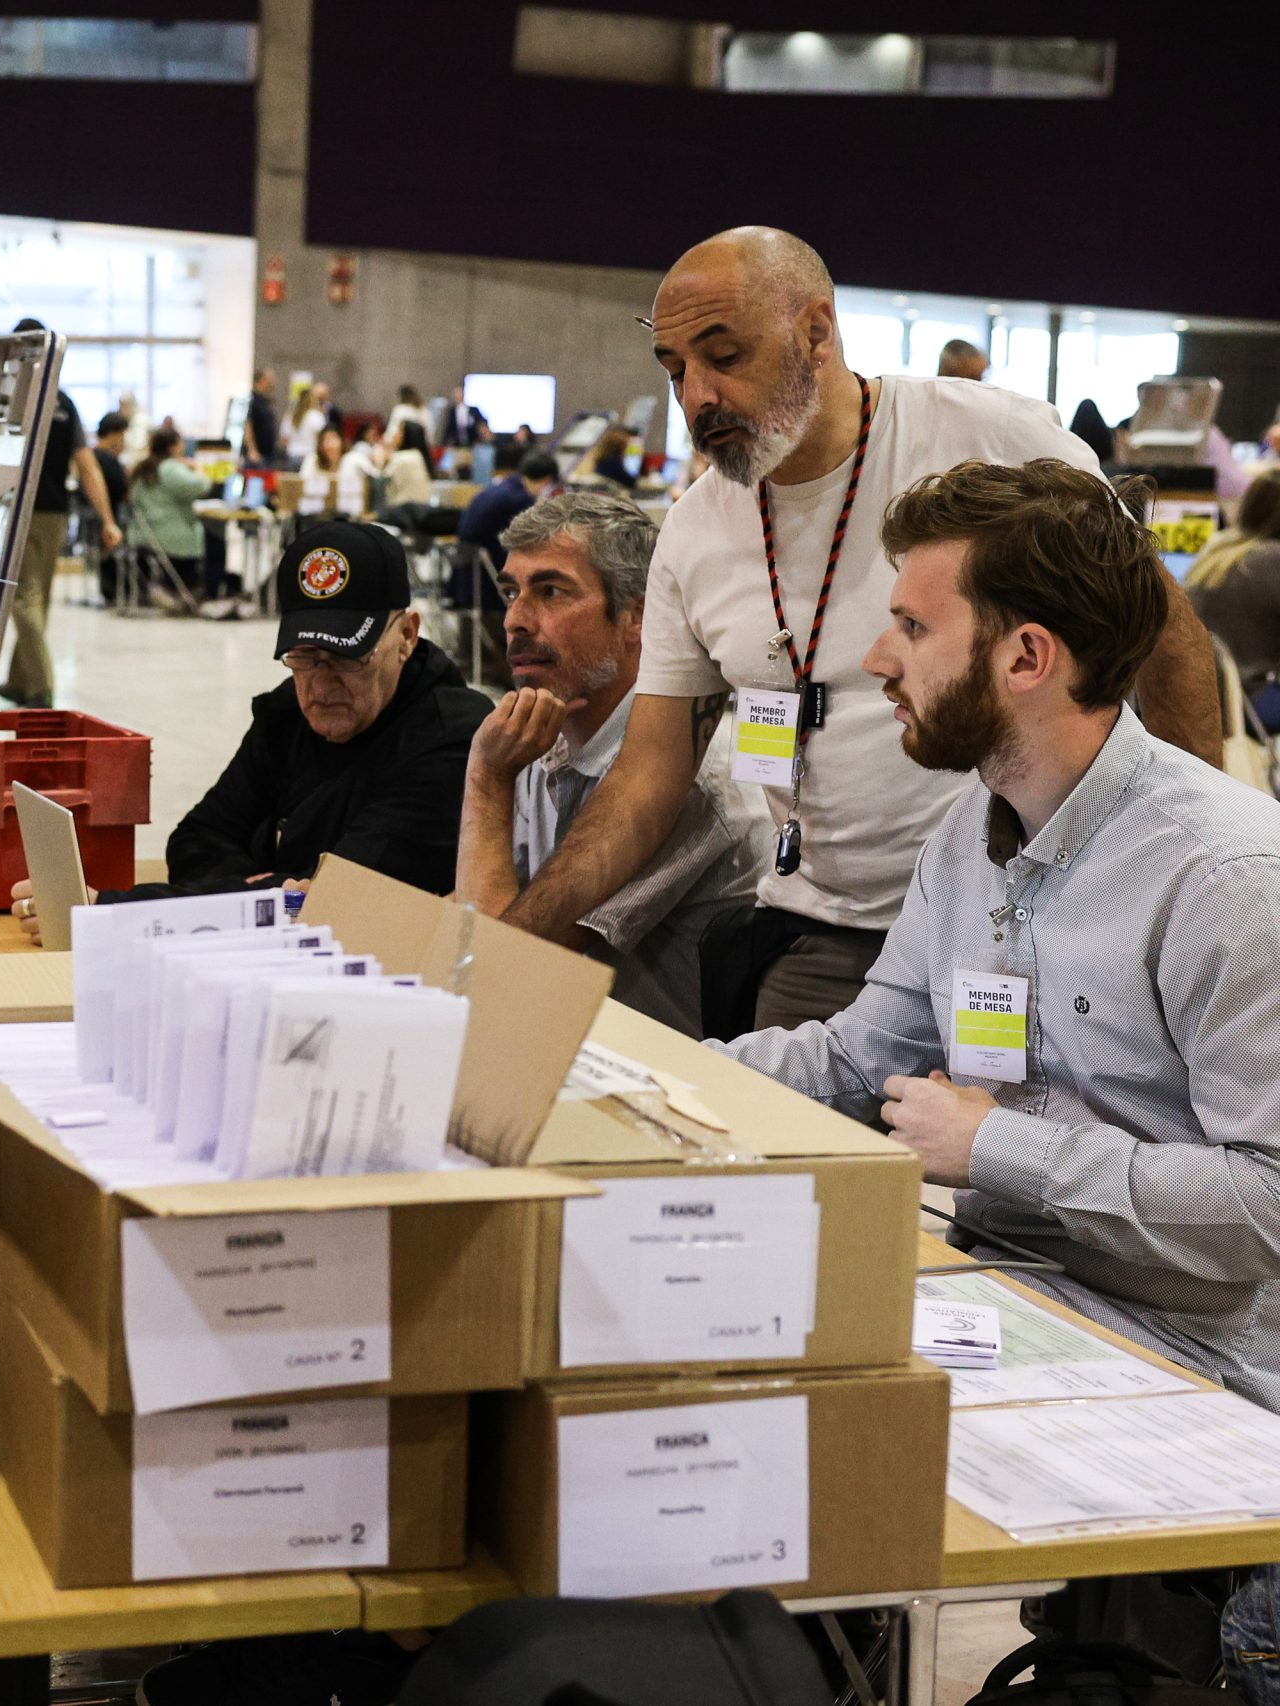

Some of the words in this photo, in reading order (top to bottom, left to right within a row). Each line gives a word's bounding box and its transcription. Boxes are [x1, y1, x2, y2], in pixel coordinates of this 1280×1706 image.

[750, 705, 786, 717] MEMBRO
[750, 715, 760, 724] DE
[762, 716, 785, 726] MESA
[968, 990, 1012, 1002] MEMBRO
[969, 1001, 981, 1011] DE
[984, 1003, 1013, 1013] MESA
[660, 1203, 715, 1218] FRANÇA
[773, 1315, 782, 1336] 1
[350, 1338, 366, 1362] 2
[655, 1433, 709, 1449] FRANÇA
[350, 1522, 366, 1545] 2
[771, 1539, 786, 1561] 3
